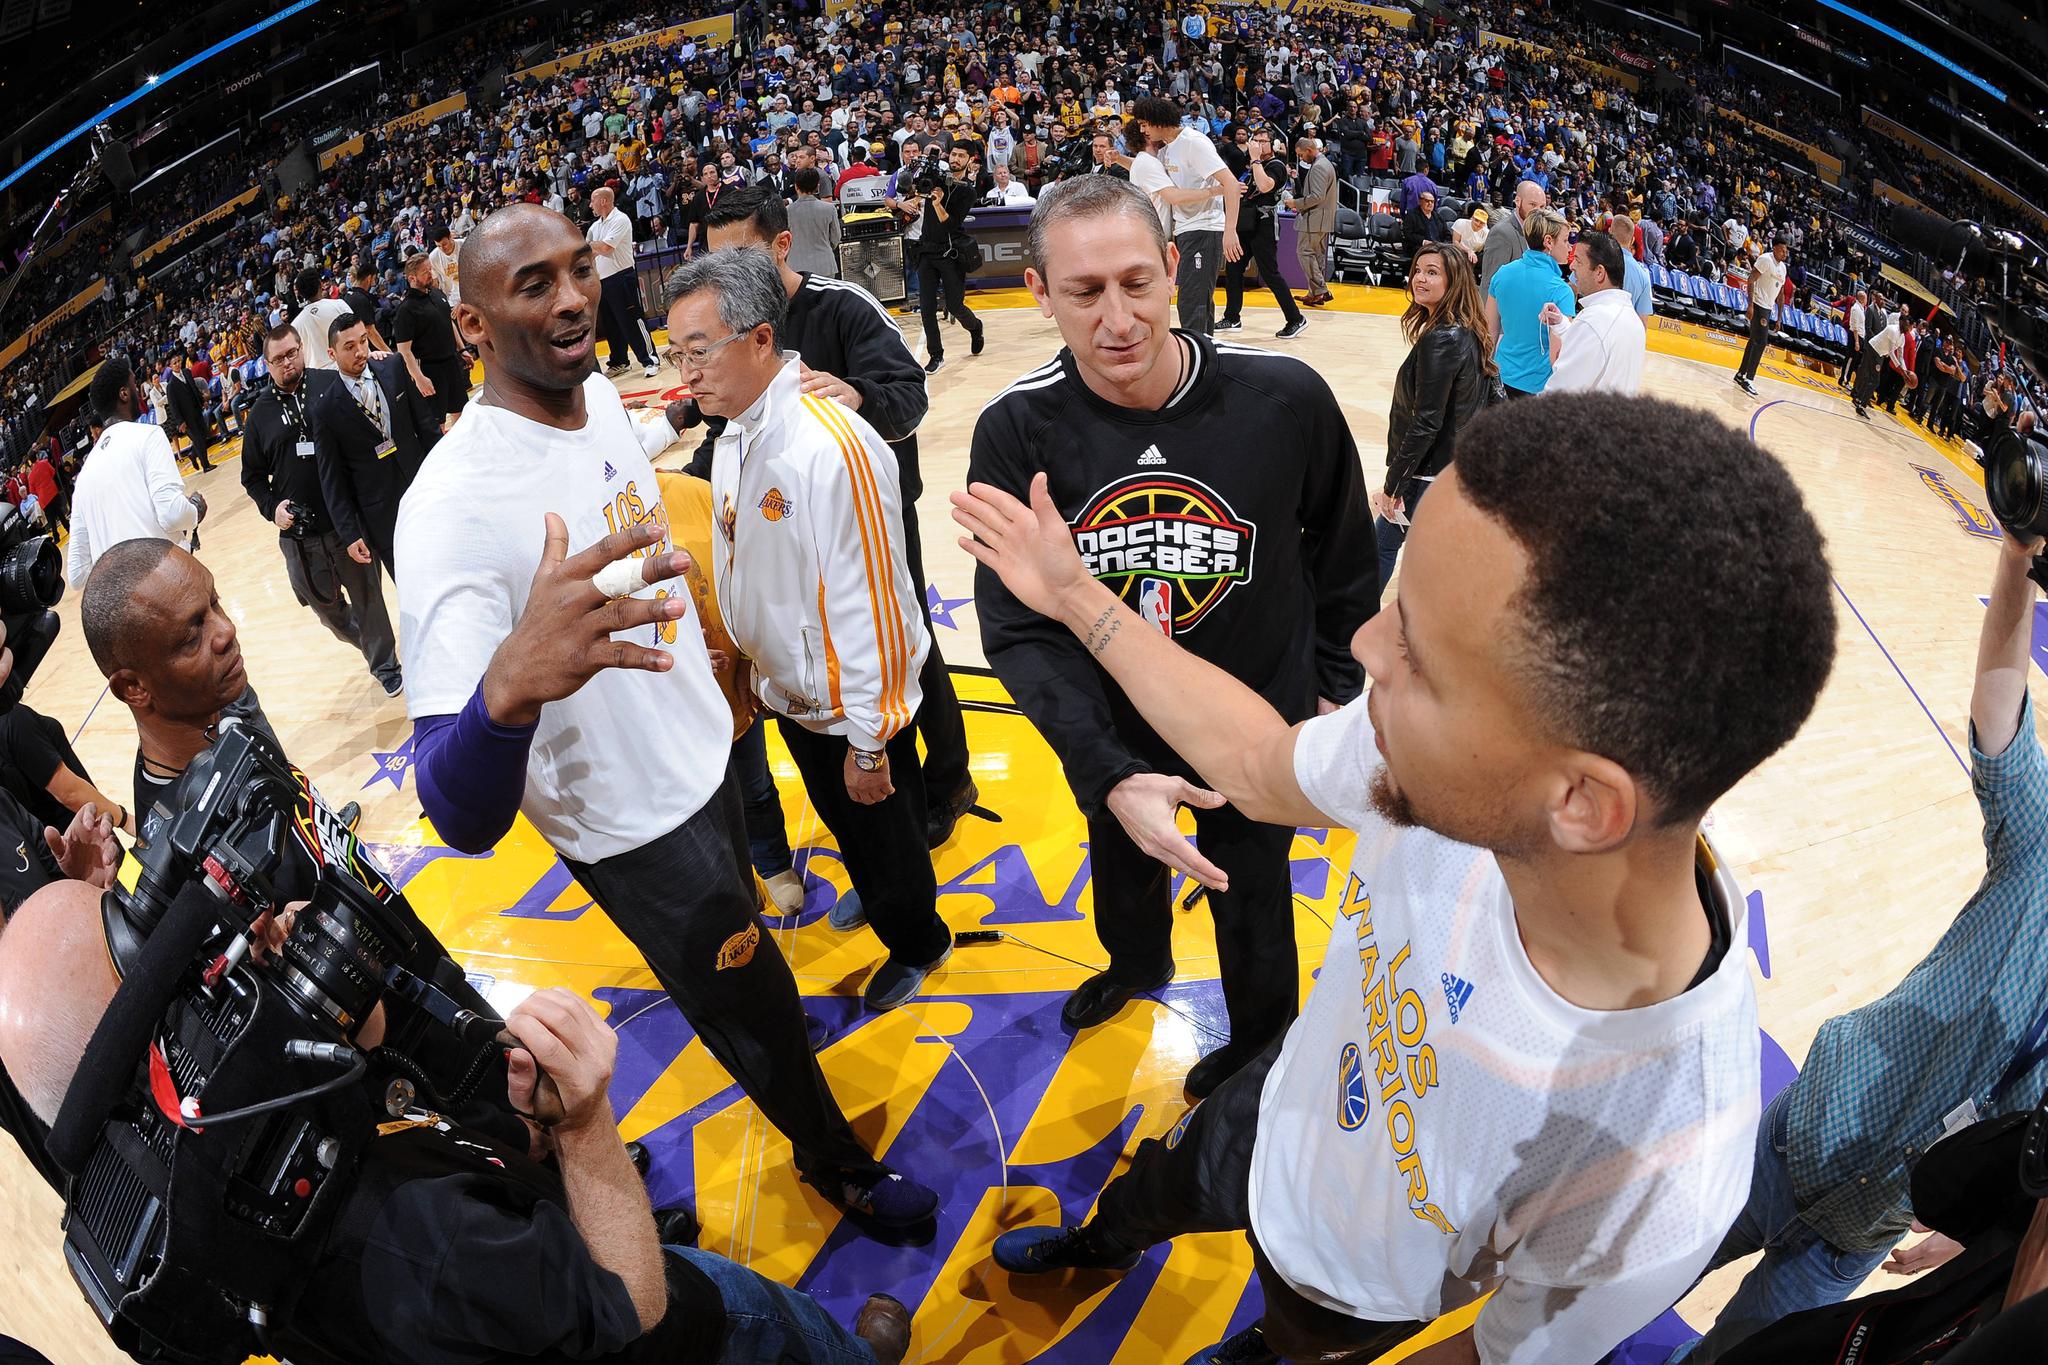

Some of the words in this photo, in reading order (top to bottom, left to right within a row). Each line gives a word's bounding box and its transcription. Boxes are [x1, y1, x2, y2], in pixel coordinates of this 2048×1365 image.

[1327, 0, 1372, 15] ANGELES
[1796, 30, 1832, 52] TOSHIBA
[225, 72, 263, 94] TOYOTA
[1844, 226, 1869, 243] BUD
[1868, 239, 1901, 260] LIGHT
[1136, 457, 1167, 466] adidas
[603, 480, 645, 535] LOS
[757, 493, 794, 519] LAKERS
[1076, 520, 1239, 553] NOCHES
[384, 756, 408, 772] '49
[1441, 971, 1460, 1025] adidas
[1387, 939, 1440, 1099] LOS
[1339, 871, 1460, 1235] WARRIORS
[1845, 1324, 1868, 1365] anon
